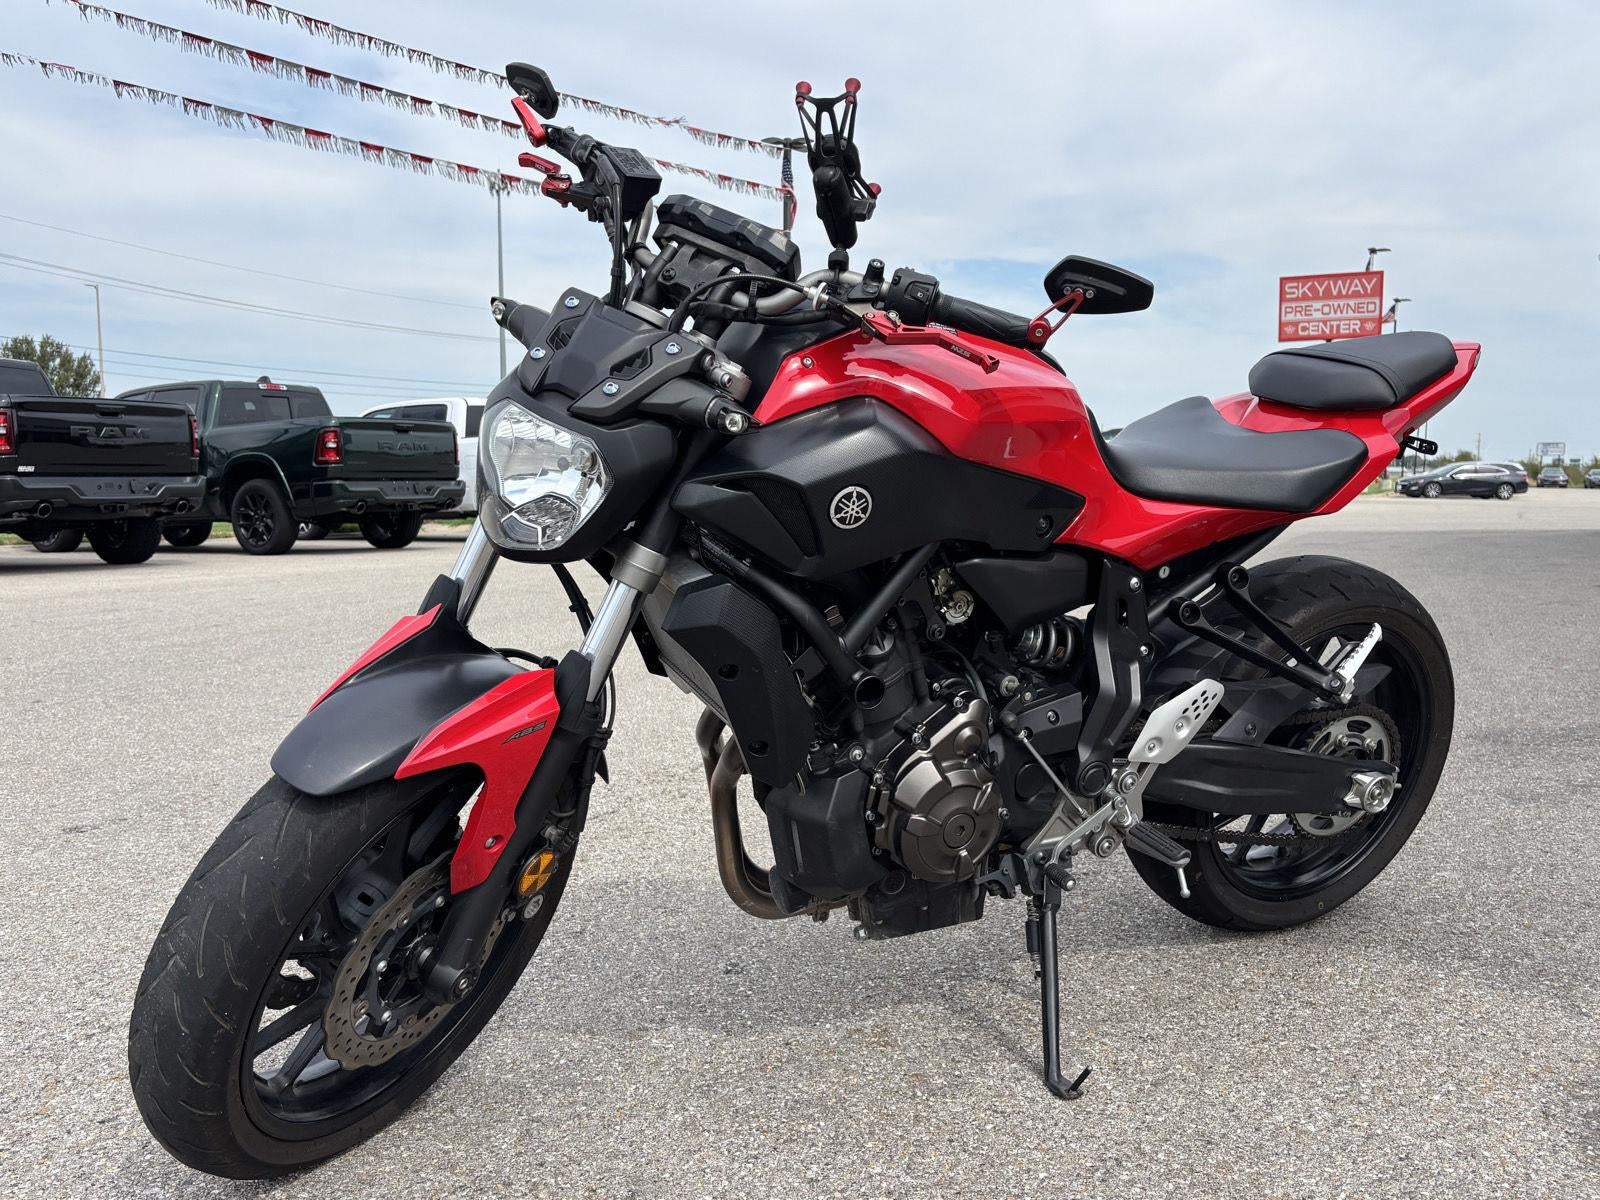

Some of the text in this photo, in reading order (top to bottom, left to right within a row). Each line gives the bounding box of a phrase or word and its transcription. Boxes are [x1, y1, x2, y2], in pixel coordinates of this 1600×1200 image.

[1285, 278, 1377, 298] SKYWAY
[1284, 301, 1376, 317] PRE-OWNED
[1298, 320, 1360, 335] CENTER
[70, 425, 151, 440] RAM
[377, 440, 430, 451] RAM
